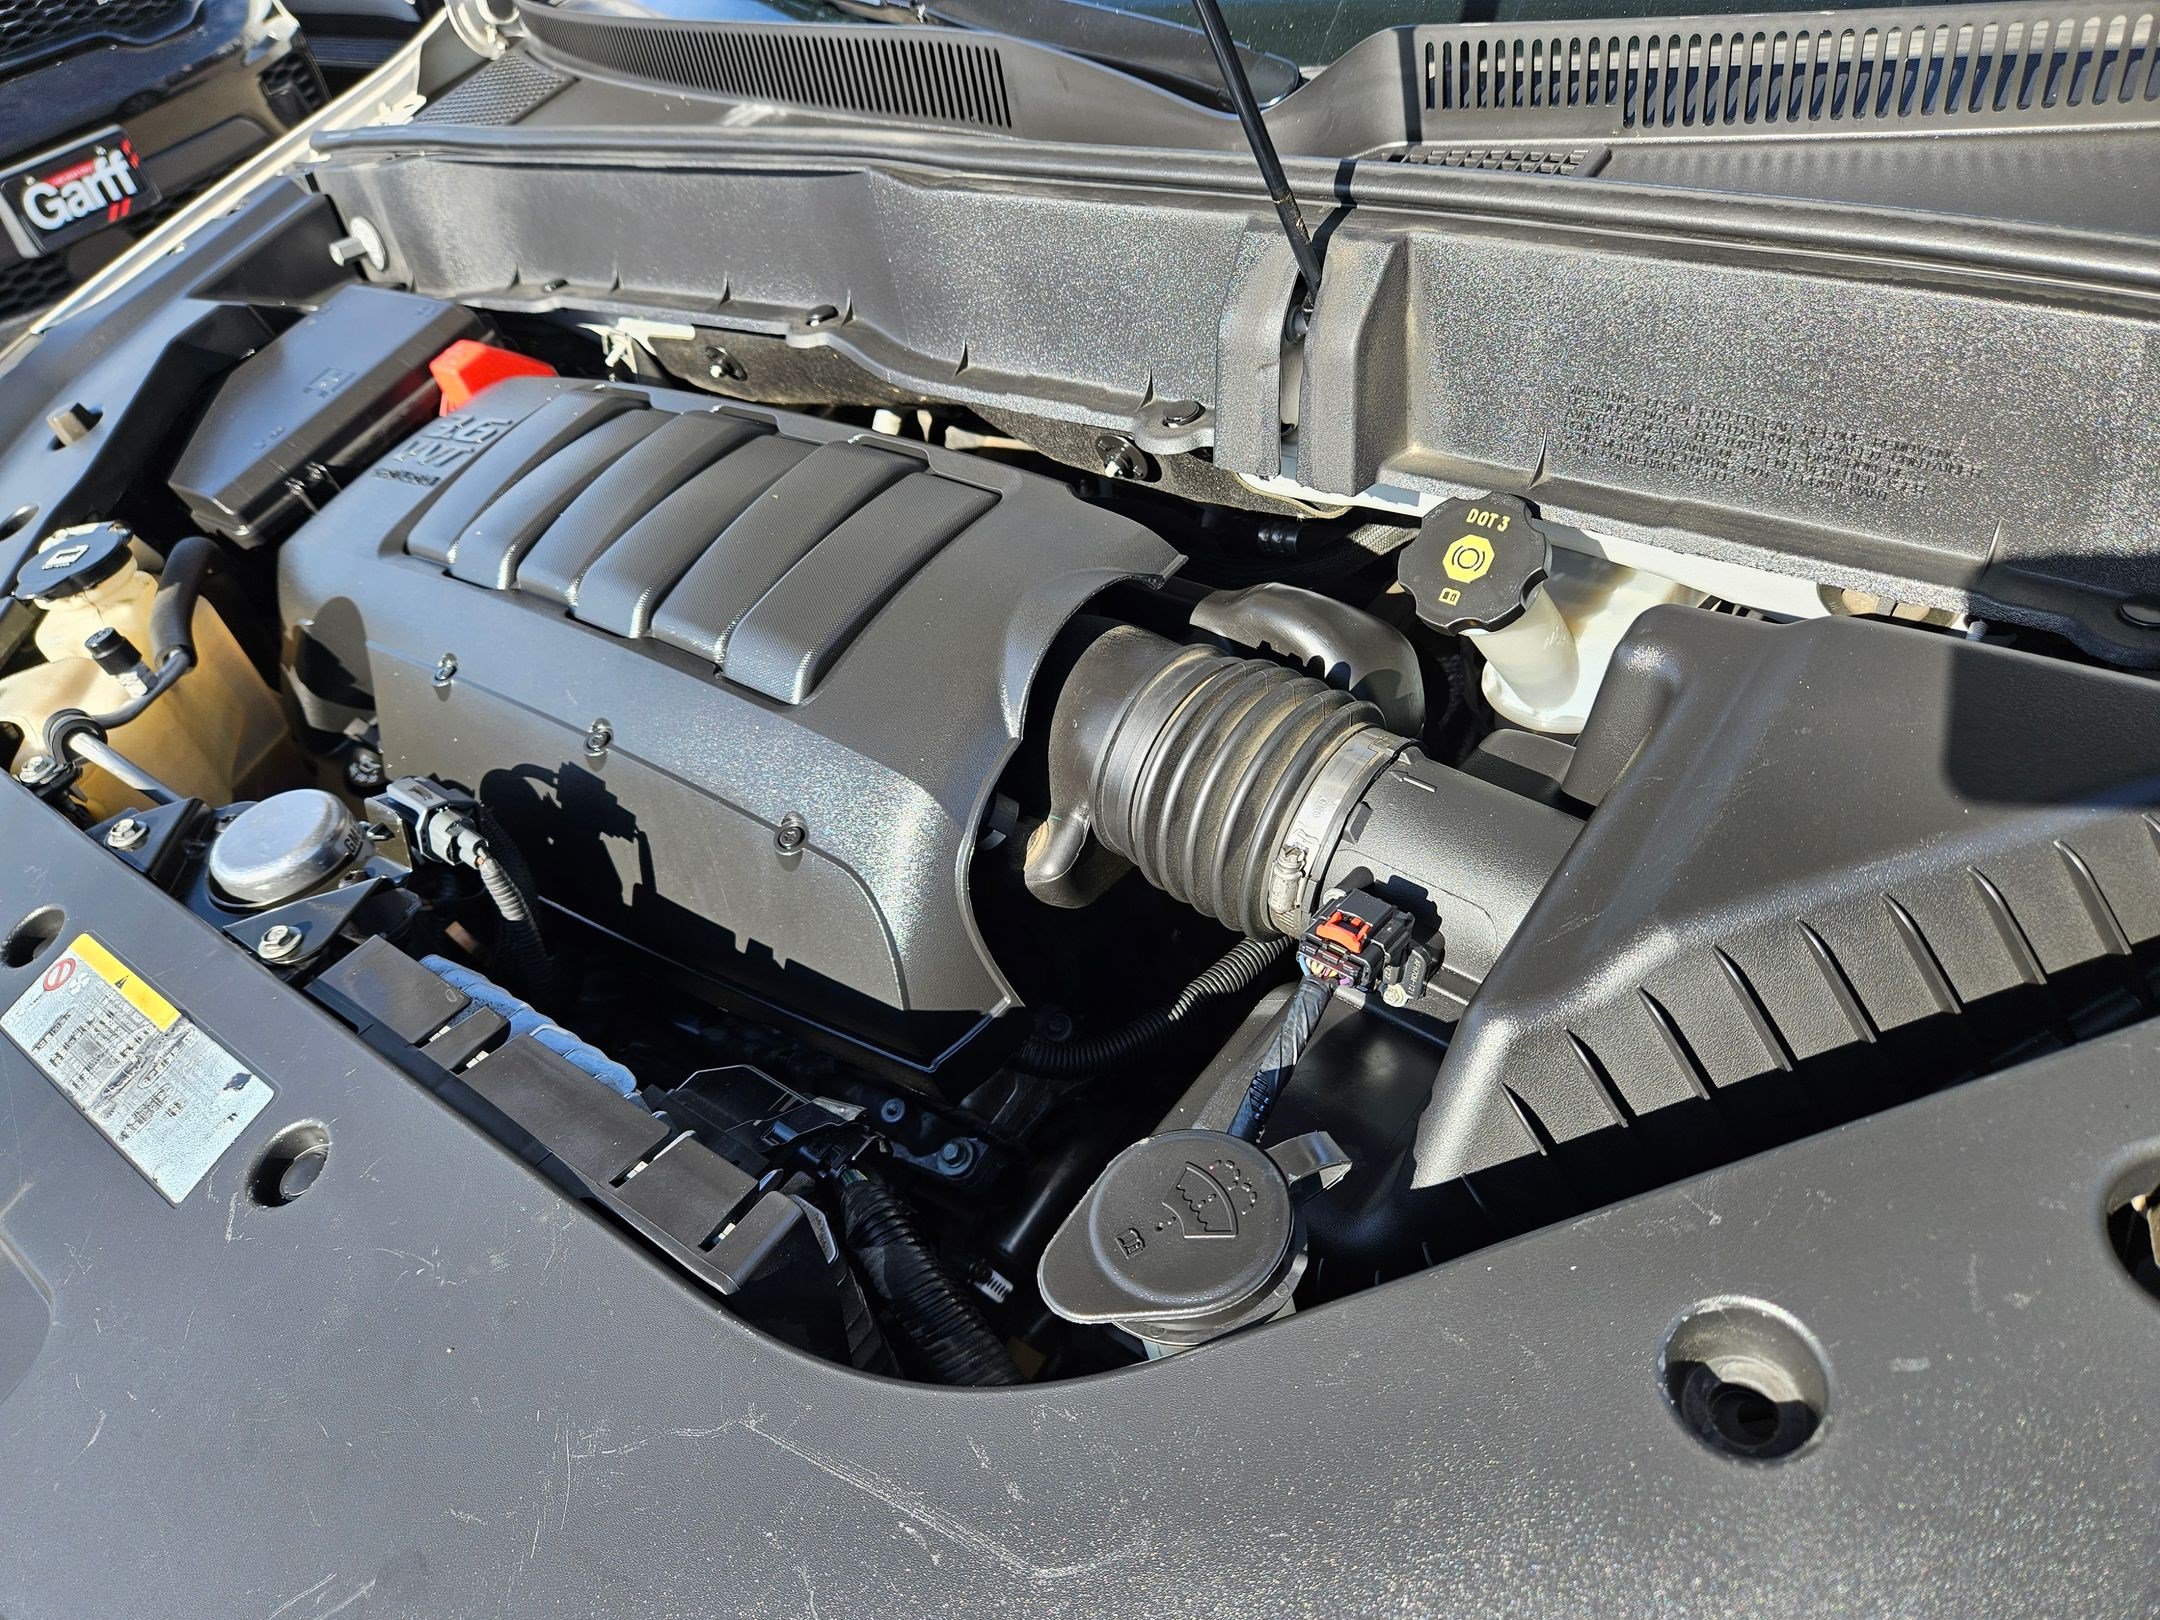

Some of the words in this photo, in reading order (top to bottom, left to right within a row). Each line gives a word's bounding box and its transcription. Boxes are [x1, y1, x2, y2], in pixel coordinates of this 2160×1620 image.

[22, 149, 138, 231] Garff
[1465, 508, 1499, 528] DOT
[1497, 515, 1511, 532] 3
